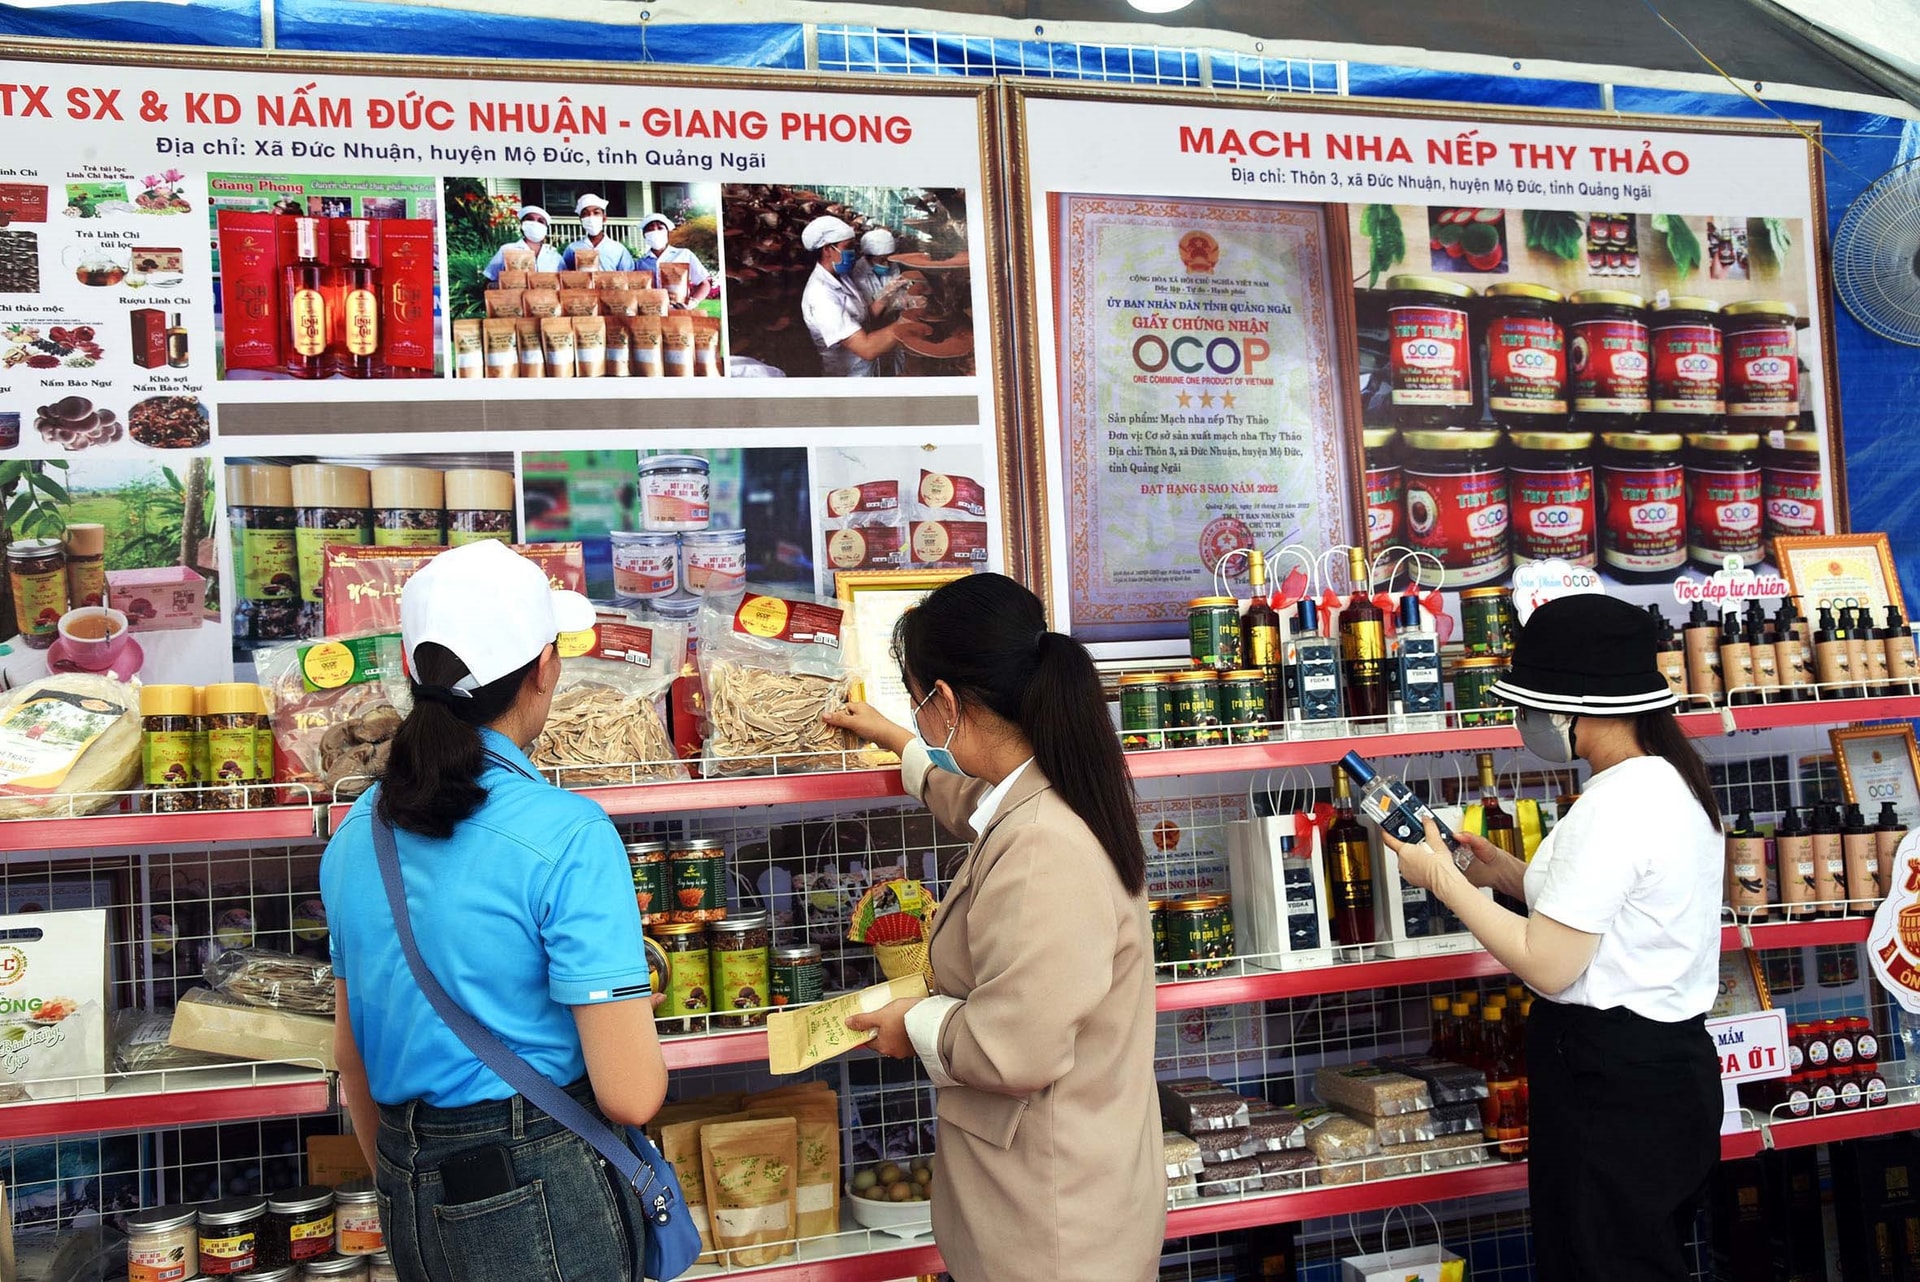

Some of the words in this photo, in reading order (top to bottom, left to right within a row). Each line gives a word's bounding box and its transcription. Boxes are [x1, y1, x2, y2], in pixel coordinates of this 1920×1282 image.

[0, 84, 53, 118] TX
[66, 87, 125, 121] SX
[139, 89, 169, 122] &
[185, 92, 242, 125] KD
[257, 81, 351, 128] NẤM
[367, 90, 455, 132] ĐỨC
[469, 96, 607, 143] NHUẬN
[620, 120, 631, 128] -
[642, 107, 768, 141] GIANG
[781, 112, 912, 145] PHONG
[156, 137, 195, 158] Địa
[203, 137, 246, 156] chỉ:
[255, 140, 284, 157] Xã
[291, 140, 336, 159] Đức
[344, 142, 423, 163] Nhuận,
[430, 145, 497, 165] huyện
[504, 146, 536, 165] Mộ
[543, 143, 591, 165] Đức,
[597, 147, 638, 165] tỉnh
[645, 149, 713, 171] Quảng
[720, 152, 767, 172] Ngãi
[1179, 126, 1311, 163] MẠCH
[1326, 134, 1414, 164] NHA
[1427, 129, 1498, 167] NẾP
[1509, 143, 1577, 171] THY
[1590, 140, 1690, 176] THẢO
[20, 168, 38, 177] Chi
[87, 172, 102, 180] Chi
[211, 178, 255, 193] Giang
[259, 179, 305, 195] Phong
[1231, 168, 1255, 185] Địa
[1259, 168, 1286, 184] chỉ:
[1290, 170, 1326, 185] Thôn
[1331, 172, 1344, 188] 3,
[1348, 172, 1363, 187] xã
[1367, 173, 1394, 189] Đức
[1398, 174, 1446, 192] Nhuận,
[1450, 177, 1490, 194] huyện
[1494, 179, 1514, 193] Mộ
[1517, 178, 1547, 196] Đức,
[1550, 179, 1575, 195] tỉnh
[1578, 181, 1620, 200] Quảng
[1623, 184, 1652, 201] Ngãi
[75, 230, 94, 238] Trà
[97, 230, 120, 239] Linh
[122, 231, 140, 239] Chi
[100, 240, 115, 248] túi
[117, 241, 134, 249] lọc
[119, 296, 147, 306] Rượu
[149, 296, 171, 305] Linh
[174, 297, 191, 305] Chi
[1124, 299, 1146, 309] BAN
[1147, 298, 1177, 310] NHÂN
[1179, 299, 1201, 311] DÂN
[1202, 298, 1228, 312] TỈNH
[1230, 299, 1265, 315] QUẢNG
[1267, 303, 1292, 315] NGÃI
[15, 303, 40, 312] thảo
[42, 304, 65, 314] mộc
[1132, 312, 1169, 330] GIẤY
[1172, 315, 1225, 332] CHỨNG
[1228, 317, 1270, 336] NHẬN
[1132, 334, 1271, 376] OCOP
[40, 379, 65, 388] Nấm
[67, 379, 88, 388] Bào
[91, 380, 113, 389] Ngư
[149, 374, 170, 383] Khô
[173, 375, 188, 384] sợi
[1133, 375, 1149, 384] ONE
[1149, 375, 1185, 385] COMMUNE
[1186, 376, 1201, 385] ONE
[1201, 376, 1234, 386] PRODUCT
[1234, 377, 1244, 386] OF
[1245, 377, 1275, 387] VIETNAM
[133, 384, 157, 392] Nấm
[159, 384, 180, 392] Bào
[182, 384, 203, 393] Ngư
[1107, 412, 1127, 425] Sản
[1129, 411, 1159, 426] phẩm:
[1160, 414, 1187, 427] Mạch
[1188, 415, 1206, 425] nha
[1207, 413, 1225, 427] nếp
[1227, 414, 1244, 427] Thy
[1246, 413, 1270, 425] Thảo
[1108, 430, 1129, 441] Đơn
[1131, 431, 1144, 443] vị:
[1144, 430, 1158, 441] Cơ
[1159, 430, 1172, 441] sở
[1172, 431, 1189, 441] sản
[1190, 429, 1212, 441] xuất
[1213, 431, 1239, 443] mạch
[1240, 431, 1258, 441] nha
[1259, 431, 1278, 443] Thy
[1279, 431, 1302, 441] Thảo
[1108, 446, 1125, 458] Địa
[1126, 446, 1144, 456] chỉ:
[1144, 446, 1168, 456] Thôn
[1179, 447, 1190, 456] xã
[1190, 446, 1208, 456] Đức
[1209, 446, 1241, 459] Nhuận,
[1241, 446, 1269, 460] huyện
[1269, 447, 1283, 458] Mộ
[1284, 446, 1304, 458] Đức,
[1108, 462, 1128, 473] tỉnh
[1129, 462, 1159, 475] Quảng
[1160, 462, 1182, 474] Ngãi
[1140, 484, 1164, 496] ĐẠT
[1166, 484, 1198, 496] HẠNG
[1199, 483, 1206, 494] 3
[1207, 484, 1229, 494] SAO
[1231, 481, 1255, 494] NĂM
[1256, 484, 1279, 494] 2022
[1562, 575, 1597, 588] OCOP
[1747, 578, 1787, 597] nhiên
[1412, 668, 1433, 676] VODKA
[1287, 901, 1310, 909] VODKA
[1718, 1026, 1745, 1046] MẮM
[1748, 1046, 1777, 1070] ỚT
